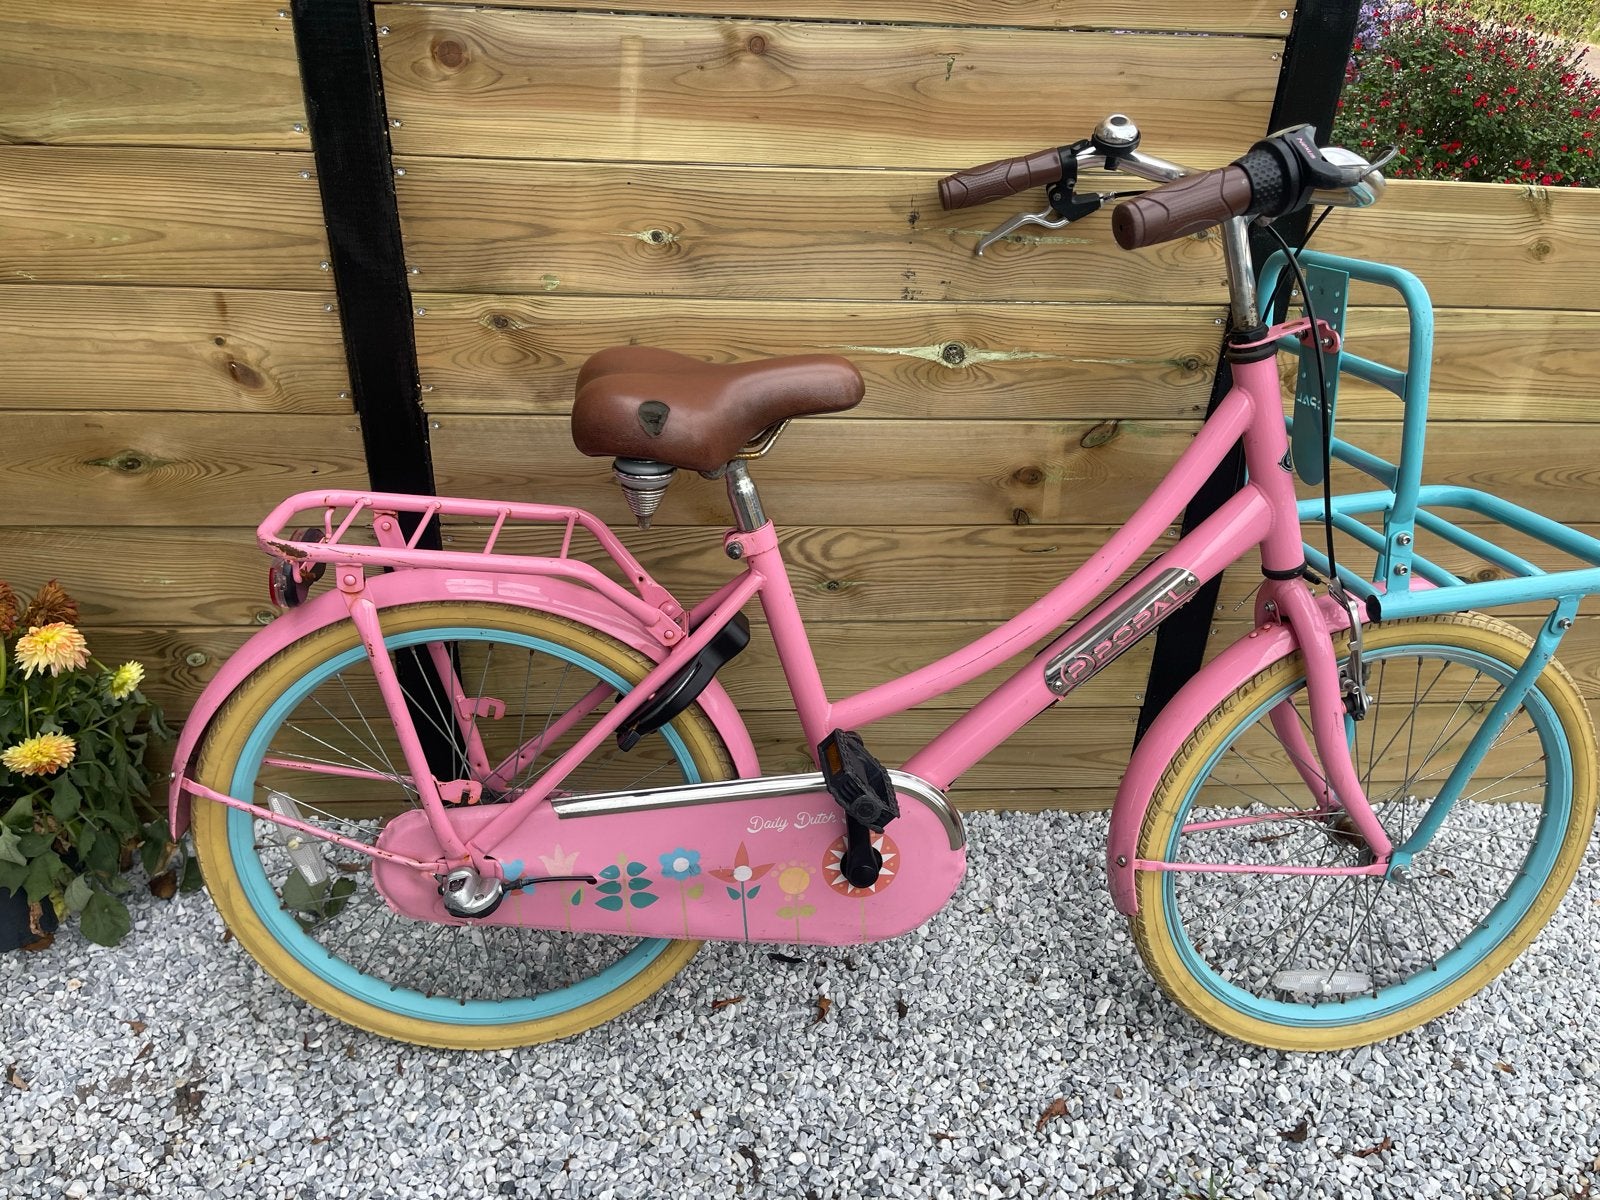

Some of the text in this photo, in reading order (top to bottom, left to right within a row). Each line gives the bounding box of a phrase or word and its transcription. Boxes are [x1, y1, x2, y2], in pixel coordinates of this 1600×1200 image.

[1093, 589, 1192, 659] POPAL
[746, 815, 789, 834] Daily
[793, 811, 836, 829] Dutch
